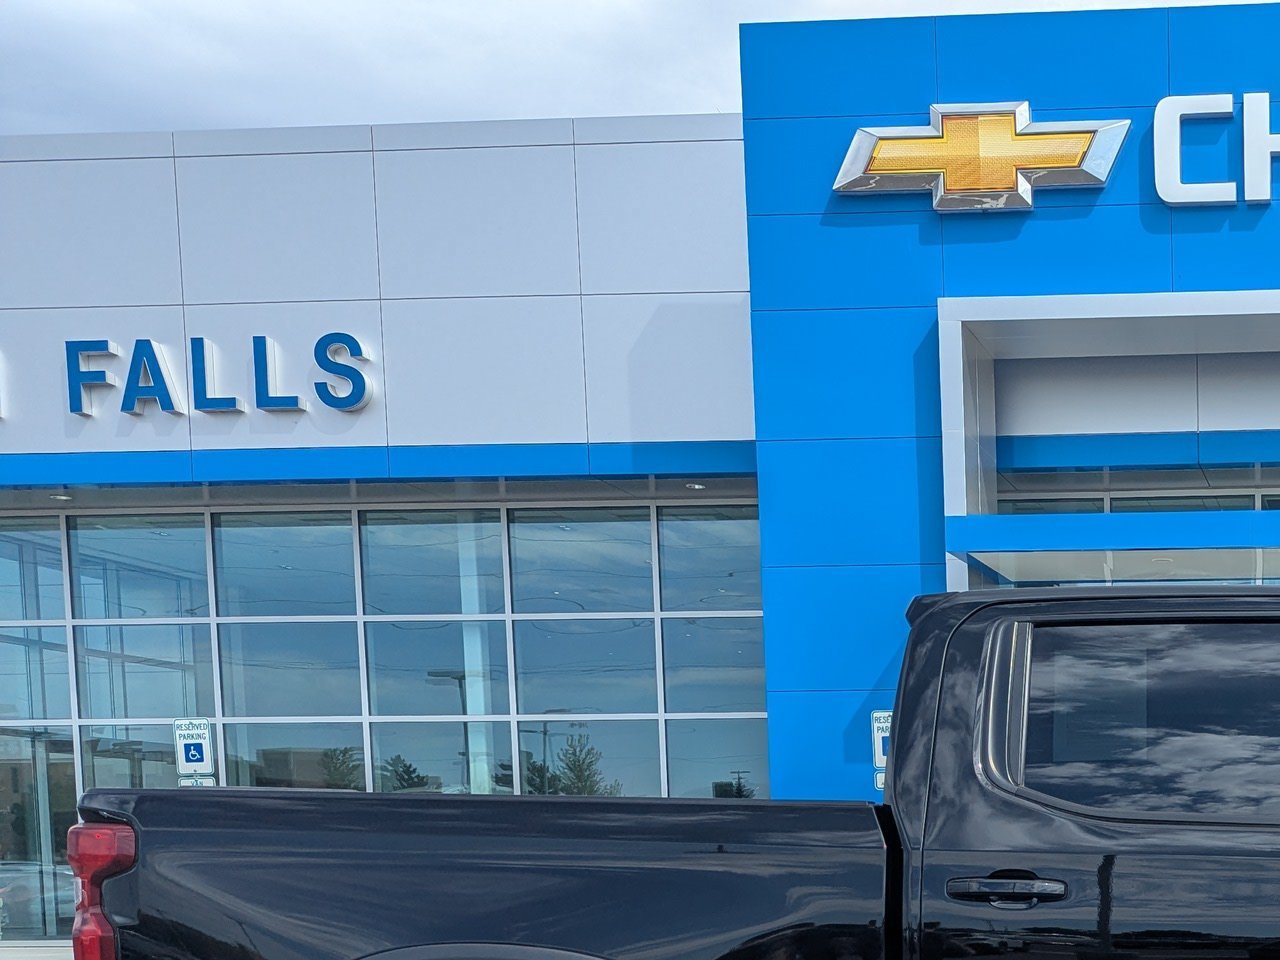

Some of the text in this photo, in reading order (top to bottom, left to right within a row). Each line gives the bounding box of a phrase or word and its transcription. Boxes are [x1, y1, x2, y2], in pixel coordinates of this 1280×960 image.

[65, 332, 370, 415] FALLS
[175, 723, 208, 731] RESERVED
[178, 732, 207, 741] PARKING
